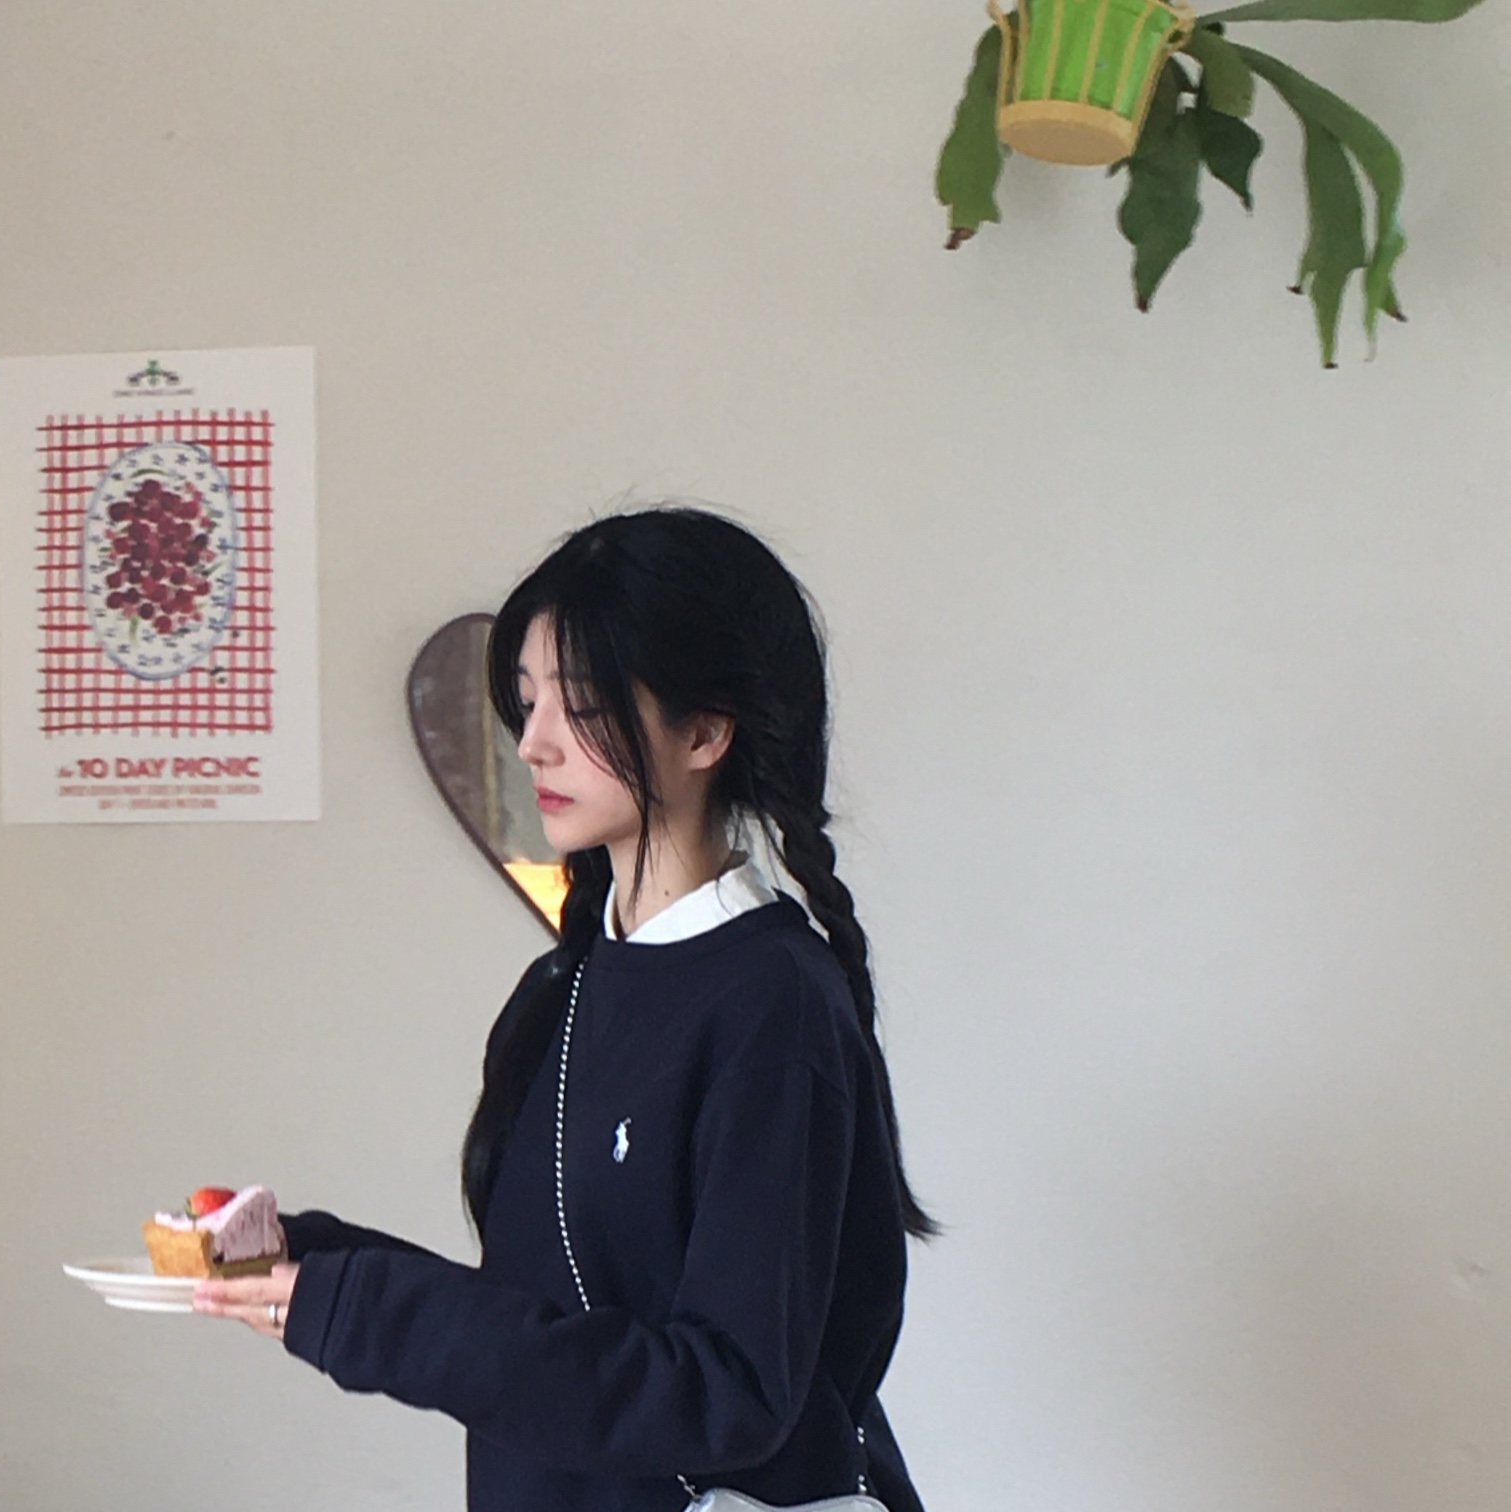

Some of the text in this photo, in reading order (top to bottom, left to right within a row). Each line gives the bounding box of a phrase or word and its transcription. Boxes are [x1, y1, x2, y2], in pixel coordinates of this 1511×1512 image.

[78, 757, 110, 779] 10
[115, 757, 167, 778] DAY
[172, 756, 260, 778] PICNIC
